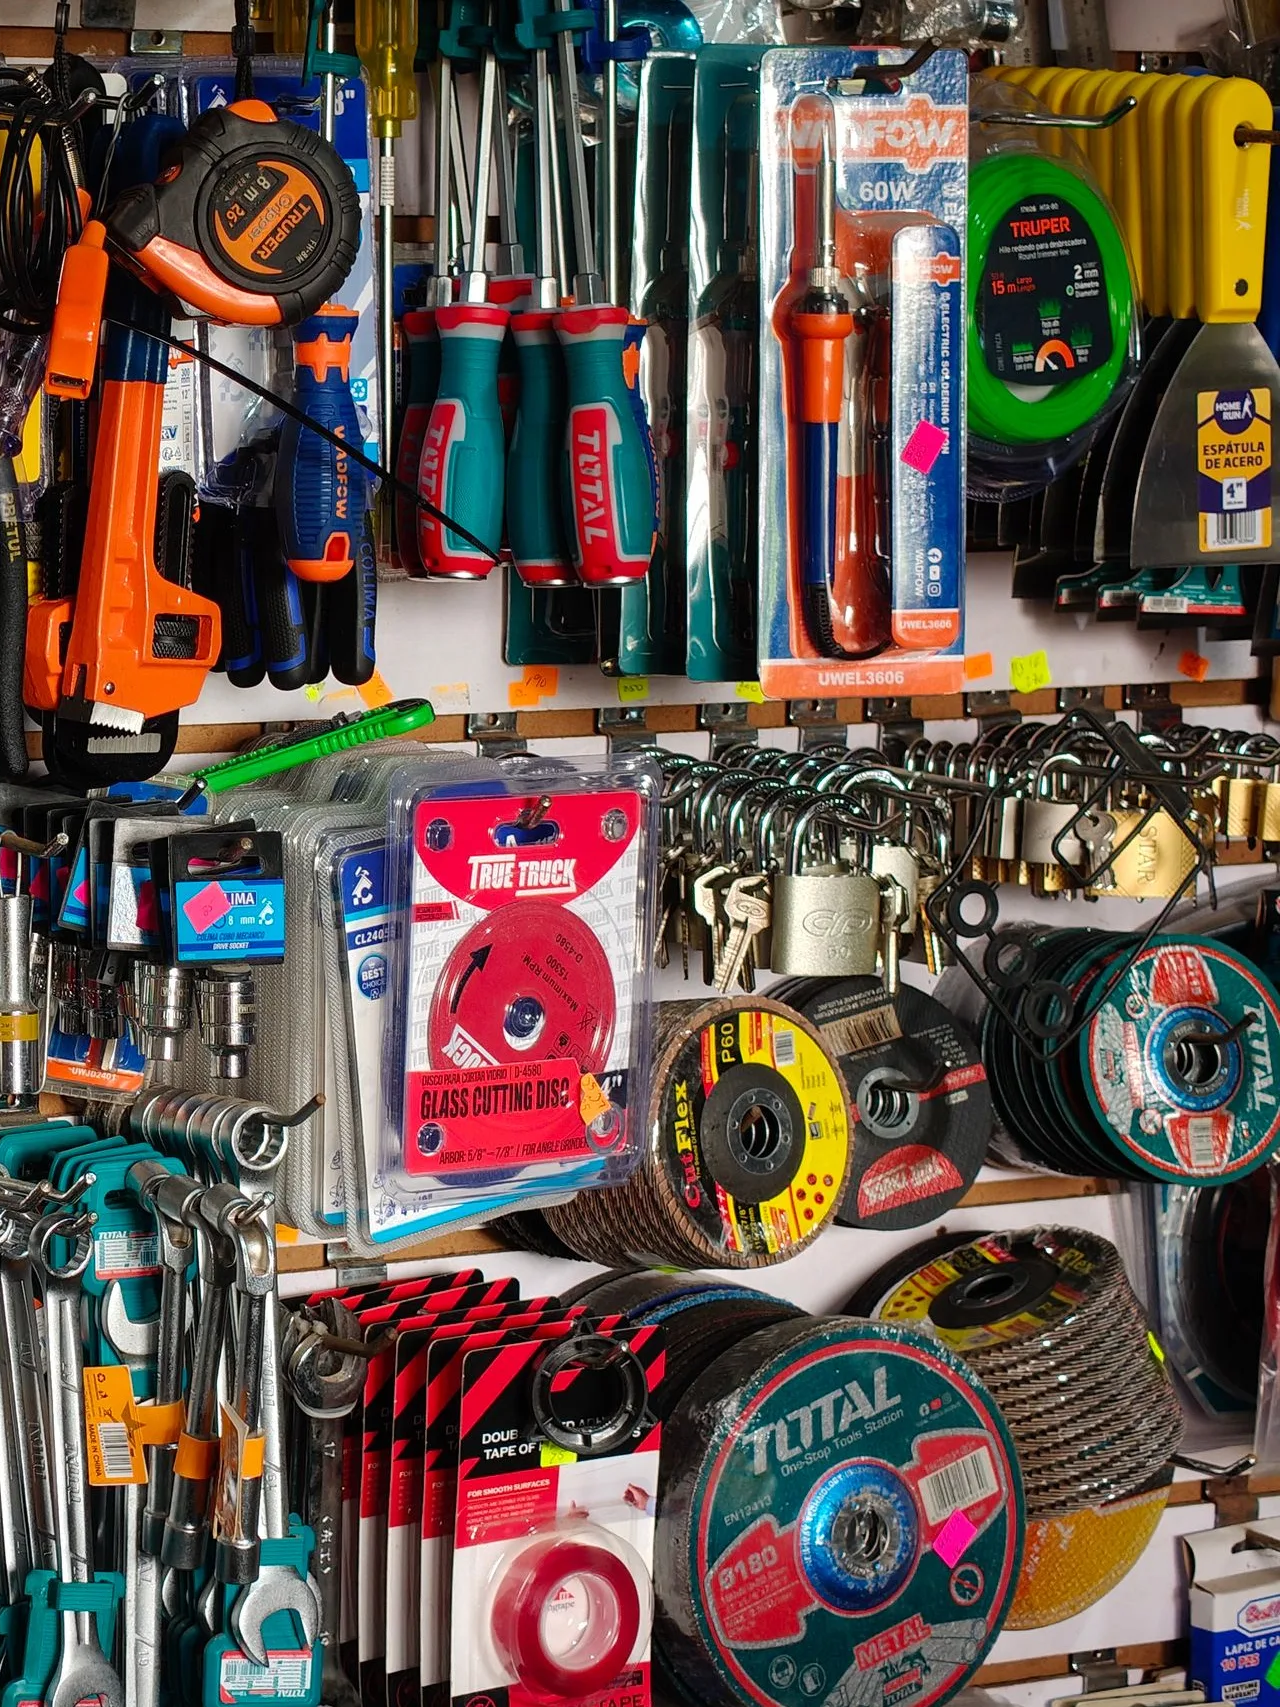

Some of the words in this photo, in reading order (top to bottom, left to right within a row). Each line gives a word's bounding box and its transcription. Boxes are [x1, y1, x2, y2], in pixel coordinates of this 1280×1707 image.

[257, 176, 271, 190] 8
[859, 181, 917, 202] 60W
[248, 193, 294, 242] Gripper
[1010, 216, 1071, 239] TRUPER
[256, 202, 311, 260] TRUPER
[296, 239, 318, 264] FH-8M
[1011, 243, 1035, 253] redondo
[1049, 237, 1087, 250] desbrozadora
[1018, 252, 1036, 261] Round
[1037, 250, 1058, 260] trimmer
[1059, 248, 1070, 257] line
[1074, 264, 1083, 279] 2
[1084, 269, 1099, 278] mm
[991, 280, 1005, 295] 15
[940, 306, 951, 357] ELECTRIC
[940, 360, 951, 424] SOLDERING
[1215, 402, 1242, 412] HOME
[1222, 410, 1242, 420] RUN
[1203, 439, 1265, 457] ESPÁTULA
[1205, 458, 1222, 470] DE
[1223, 455, 1263, 469] ACERO
[577, 429, 609, 545] TOTAL
[359, 543, 375, 622] COLIMA
[898, 619, 953, 630] UWEL3606
[818, 670, 905, 687] UWEL3606
[1137, 825, 1158, 886] STAR
[467, 854, 516, 890] TRUE
[515, 858, 577, 897] TRUCK
[228, 914, 234, 926] 8
[240, 916, 256, 924] mm
[196, 932, 219, 941] COLIMA
[220, 932, 234, 941] CUBO
[235, 931, 265, 940] MECANICO
[213, 942, 231, 950] DRIVE
[232, 941, 249, 950] SOCKET
[555, 933, 584, 964] D-4580
[361, 967, 385, 980] BEST
[545, 955, 569, 981] 15300
[542, 971, 579, 1012] Maximum
[721, 1022, 736, 1064] P60
[422, 1075, 443, 1087] DISCO
[443, 1073, 461, 1085] PARA
[461, 1071, 486, 1083] CORTAR
[486, 1069, 507, 1082] VIDRIO
[514, 1063, 542, 1078] D-4580
[420, 1087, 468, 1121] GLASS
[472, 1082, 533, 1117] CUTTING
[536, 1077, 570, 1110] DISC
[438, 1151, 467, 1165] ARBOR:
[521, 1142, 538, 1156] FOR
[539, 1140, 560, 1154] ANGLE
[98, 1231, 129, 1239] TOTAL
[742, 1365, 903, 1476] TOTAL
[88, 1423, 96, 1444] MADE
[780, 1447, 831, 1477] One-Stop
[833, 1430, 863, 1449] Tools
[864, 1408, 904, 1435] Station
[90, 1446, 97, 1455] IN
[483, 1445, 517, 1460] TAPE
[518, 1442, 536, 1454] OF
[92, 1456, 102, 1478] CHINA
[466, 1489, 483, 1499] FOR
[483, 1485, 513, 1497] SMOOTH
[514, 1478, 550, 1492] SURFACES
[857, 1620, 928, 1665] METAL
[1225, 1641, 1253, 1656] LAPIZ
[1255, 1638, 1267, 1650] DE
